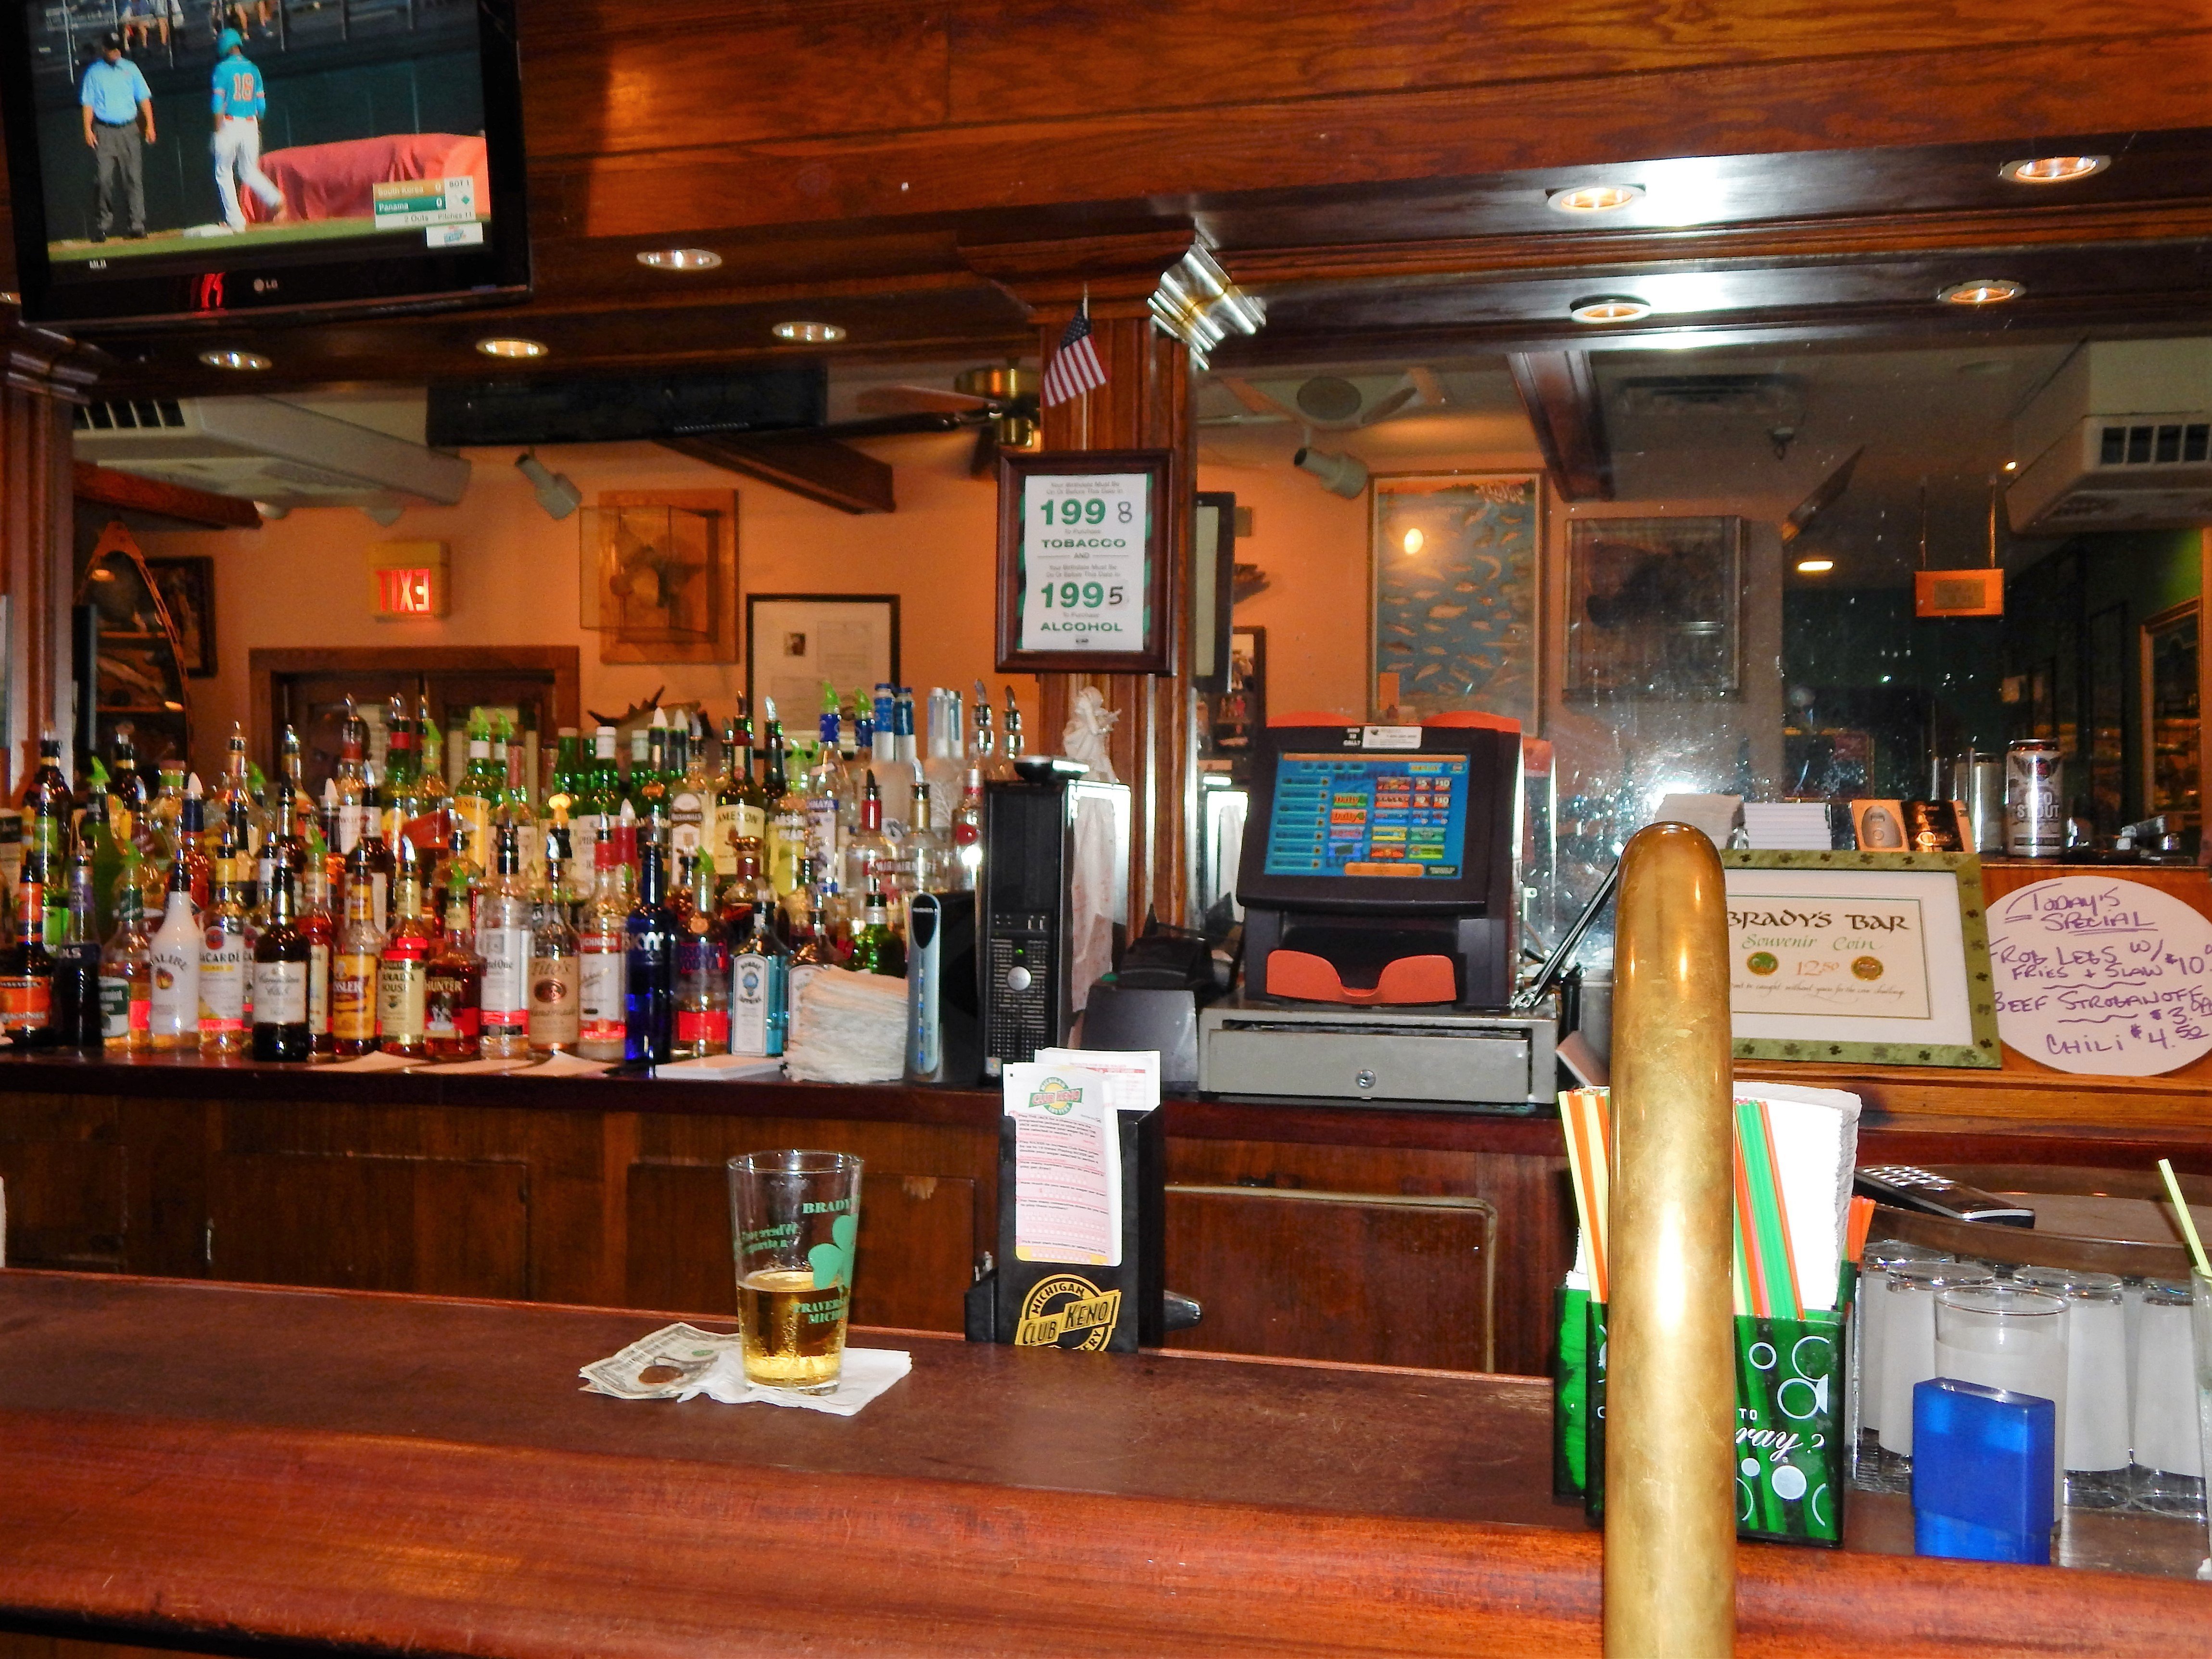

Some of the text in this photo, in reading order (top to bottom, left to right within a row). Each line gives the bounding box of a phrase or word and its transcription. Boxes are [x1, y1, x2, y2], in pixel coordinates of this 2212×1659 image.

[379, 202, 409, 212] Panama
[1041, 538, 1126, 548] TOBACCO
[1041, 581, 1124, 608] 1995
[1040, 622, 1123, 632] ALCOHOL
[1844, 913, 1911, 934] BAR
[2040, 912, 2155, 932] SPECIAL
[1741, 933, 1883, 951] Souvenir Coin
[198, 951, 240, 963] ACARDI
[1032, 1093, 1055, 1105] CLUB
[1031, 1282, 1085, 1315] MICHIGAN
[1022, 1319, 1057, 1345] CLUB
[1064, 1300, 1109, 1331] KENO
[1738, 1407, 1757, 1420] TO
